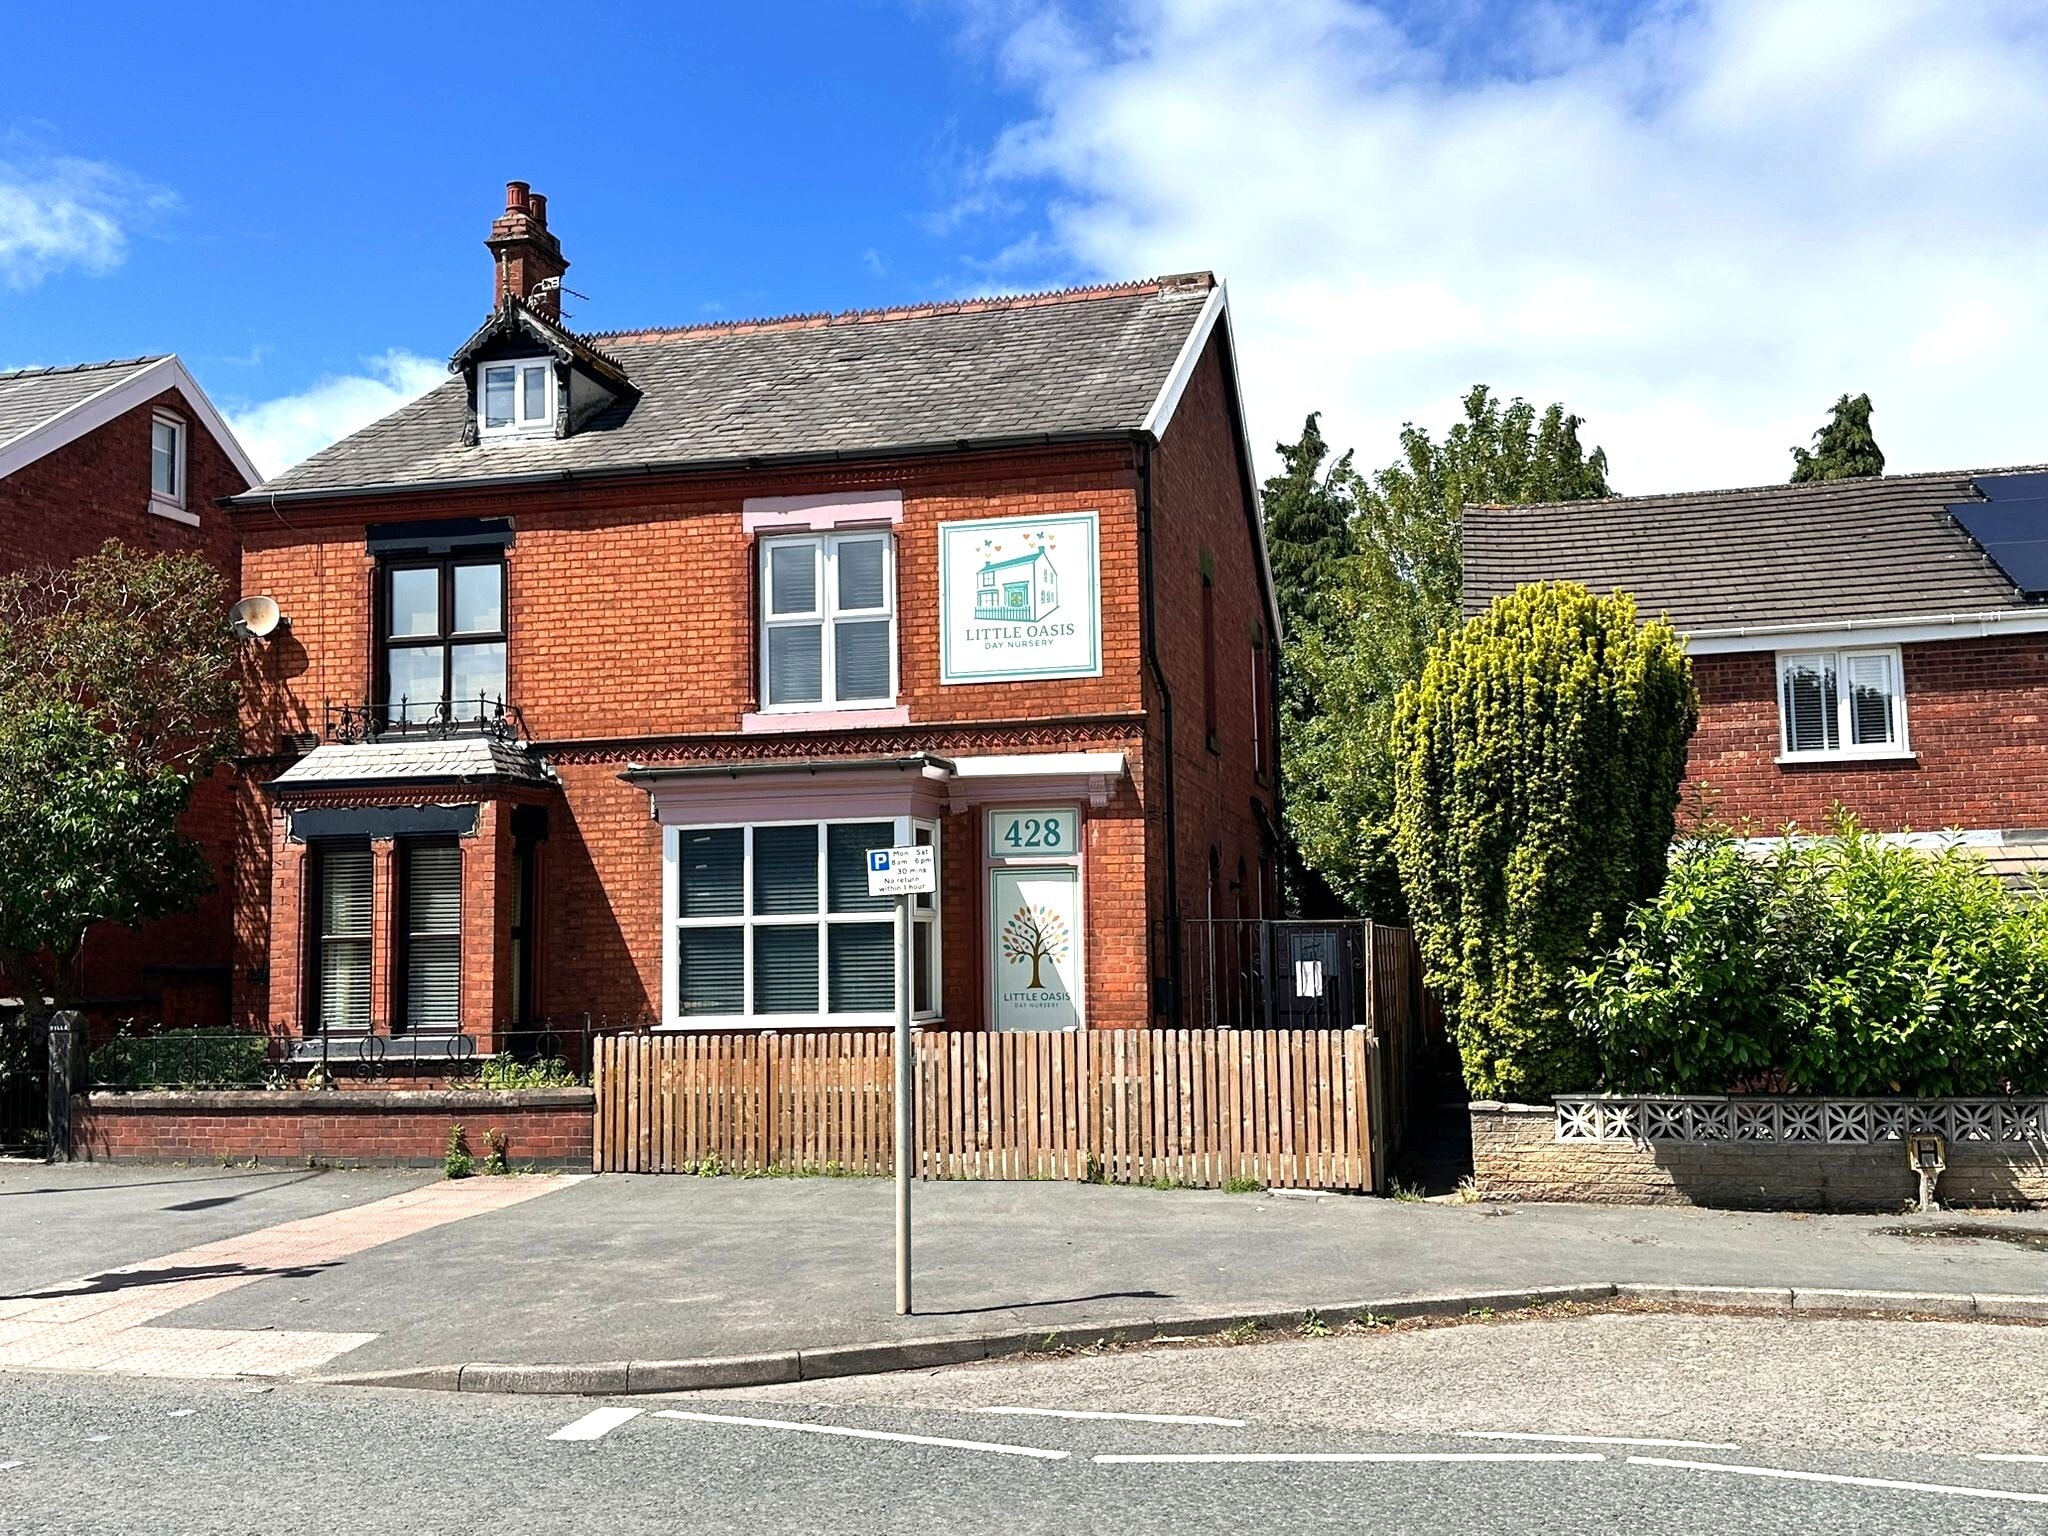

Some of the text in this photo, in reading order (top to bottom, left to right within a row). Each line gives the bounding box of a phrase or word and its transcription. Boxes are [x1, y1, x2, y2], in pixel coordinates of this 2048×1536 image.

[966, 623, 1075, 641] LITTLE OASIS
[984, 639, 1054, 649] DAY NURSERY
[1004, 818, 1061, 848] 428
[916, 848, 929, 856] Sat
[874, 853, 887, 870] P
[896, 876, 920, 884] return
[879, 885, 902, 893] within
[908, 883, 926, 891] hour
[1003, 991, 1071, 1002] LITTLE OASIS
